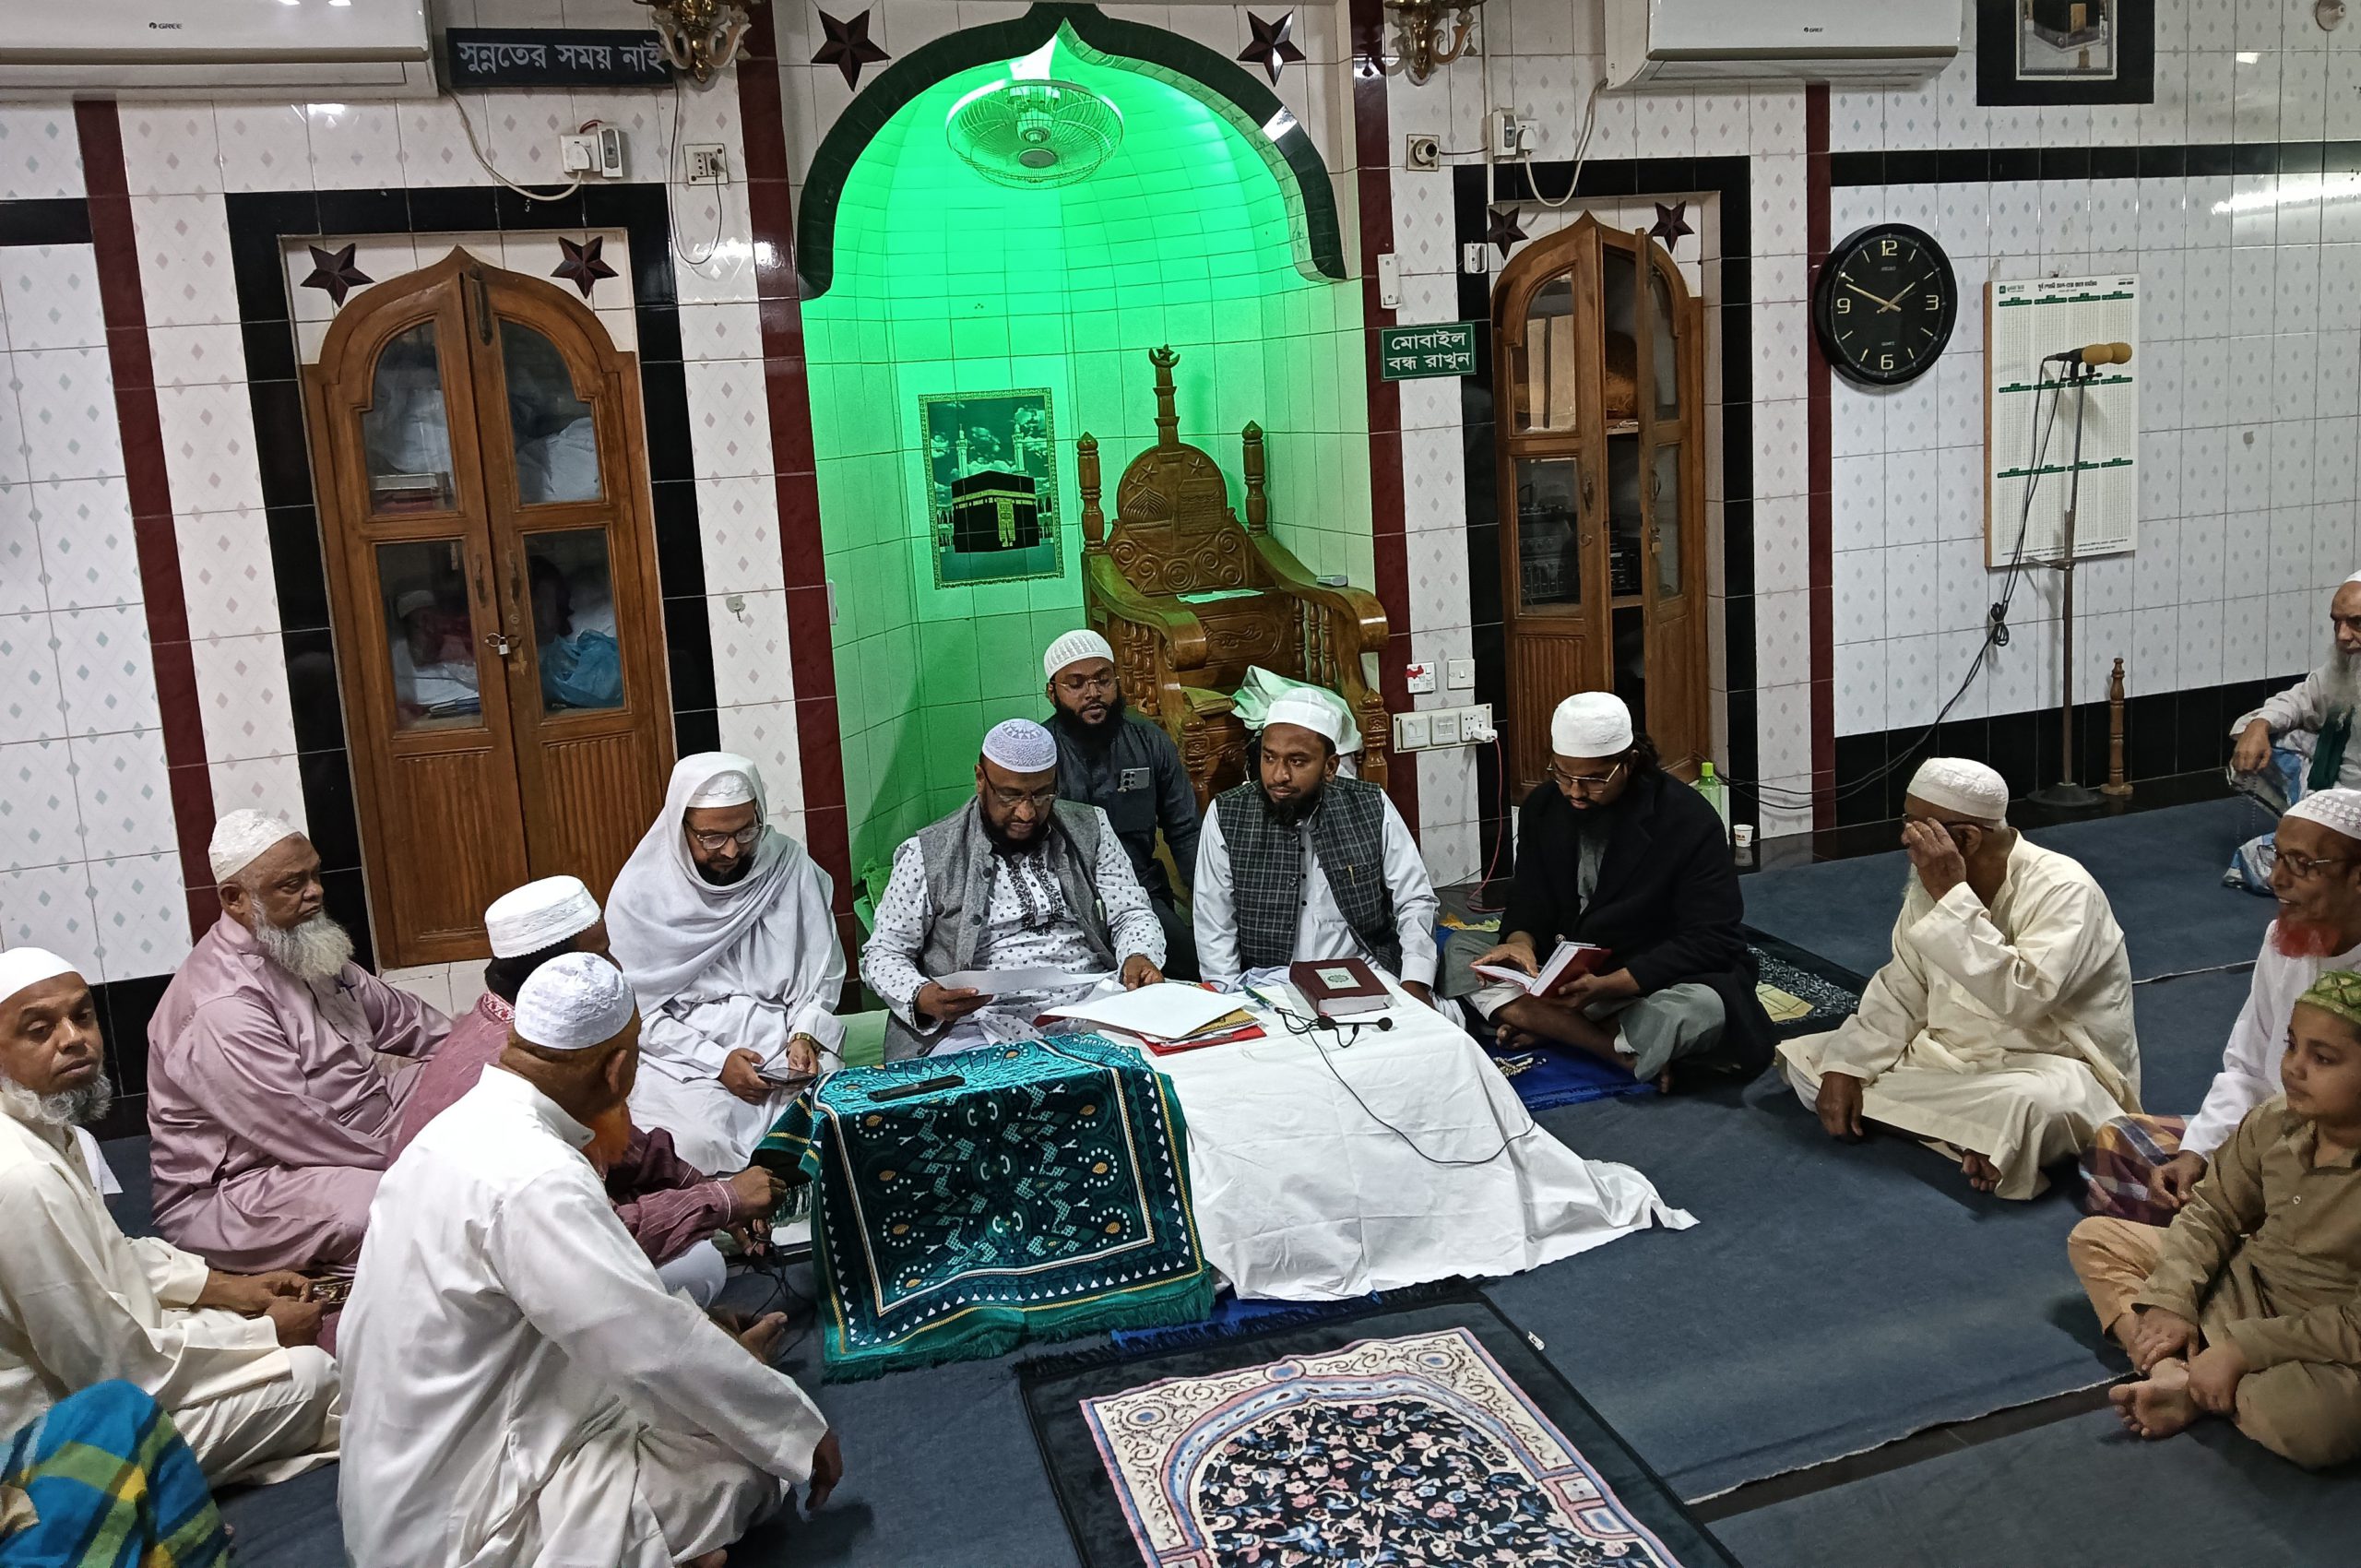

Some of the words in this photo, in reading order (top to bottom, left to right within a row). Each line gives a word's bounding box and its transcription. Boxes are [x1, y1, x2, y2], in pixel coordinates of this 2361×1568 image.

[457, 42, 547, 74] সুন্নতের
[554, 44, 612, 70] সময়
[619, 40, 666, 74] নাই
[1881, 240, 1898, 256] 12
[1836, 297, 1851, 315] 9
[1925, 294, 1940, 311] 3
[1391, 329, 1466, 350] মোবাইল
[1386, 356, 1418, 371] বন্ধ
[1423, 351, 1470, 371] রাখুন
[1880, 354, 1894, 369] 6
